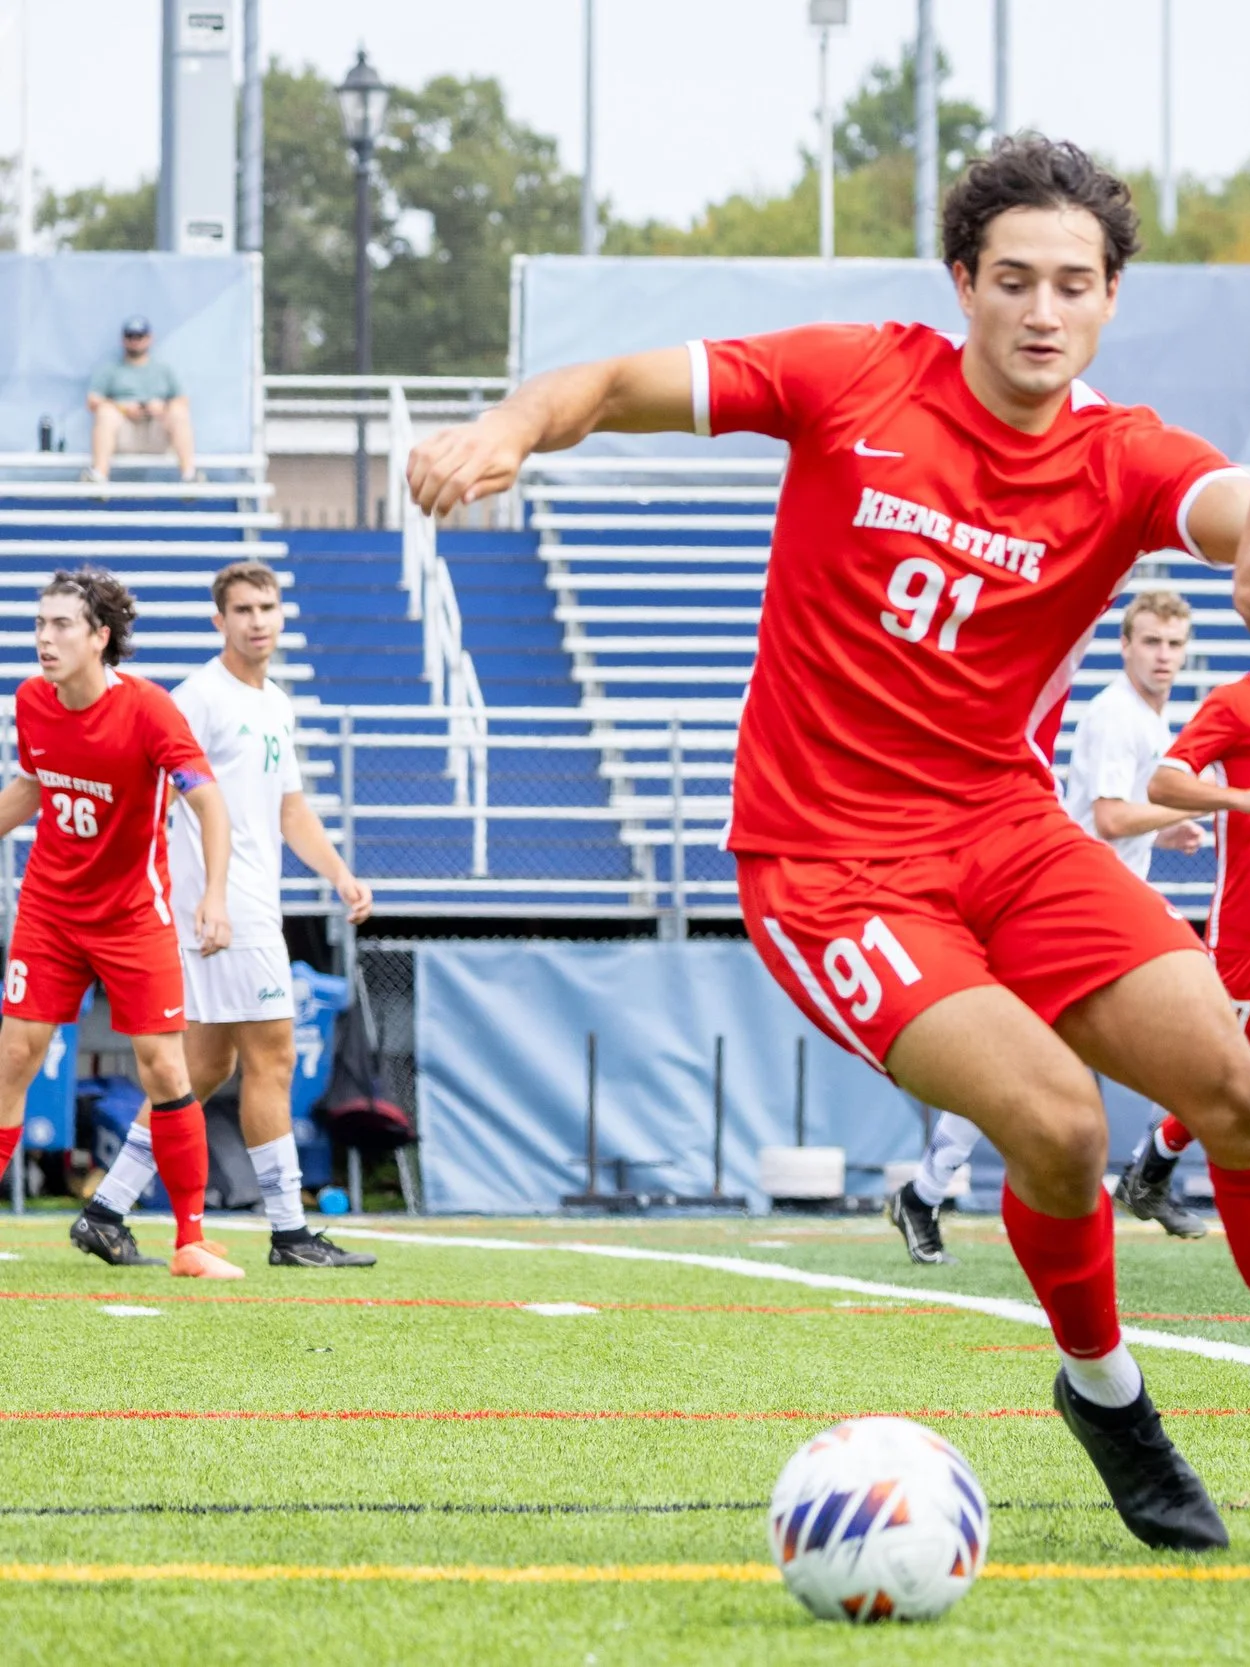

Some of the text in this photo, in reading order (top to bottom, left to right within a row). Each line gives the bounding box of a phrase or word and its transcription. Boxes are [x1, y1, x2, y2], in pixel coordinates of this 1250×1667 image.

[852, 486, 1047, 584] KEENE STATE
[879, 556, 985, 653] 91
[263, 734, 280, 773] 19
[73, 776, 114, 804] STATE
[51, 792, 99, 838] 26
[3, 958, 28, 1004] 6
[823, 914, 923, 1023] 91
